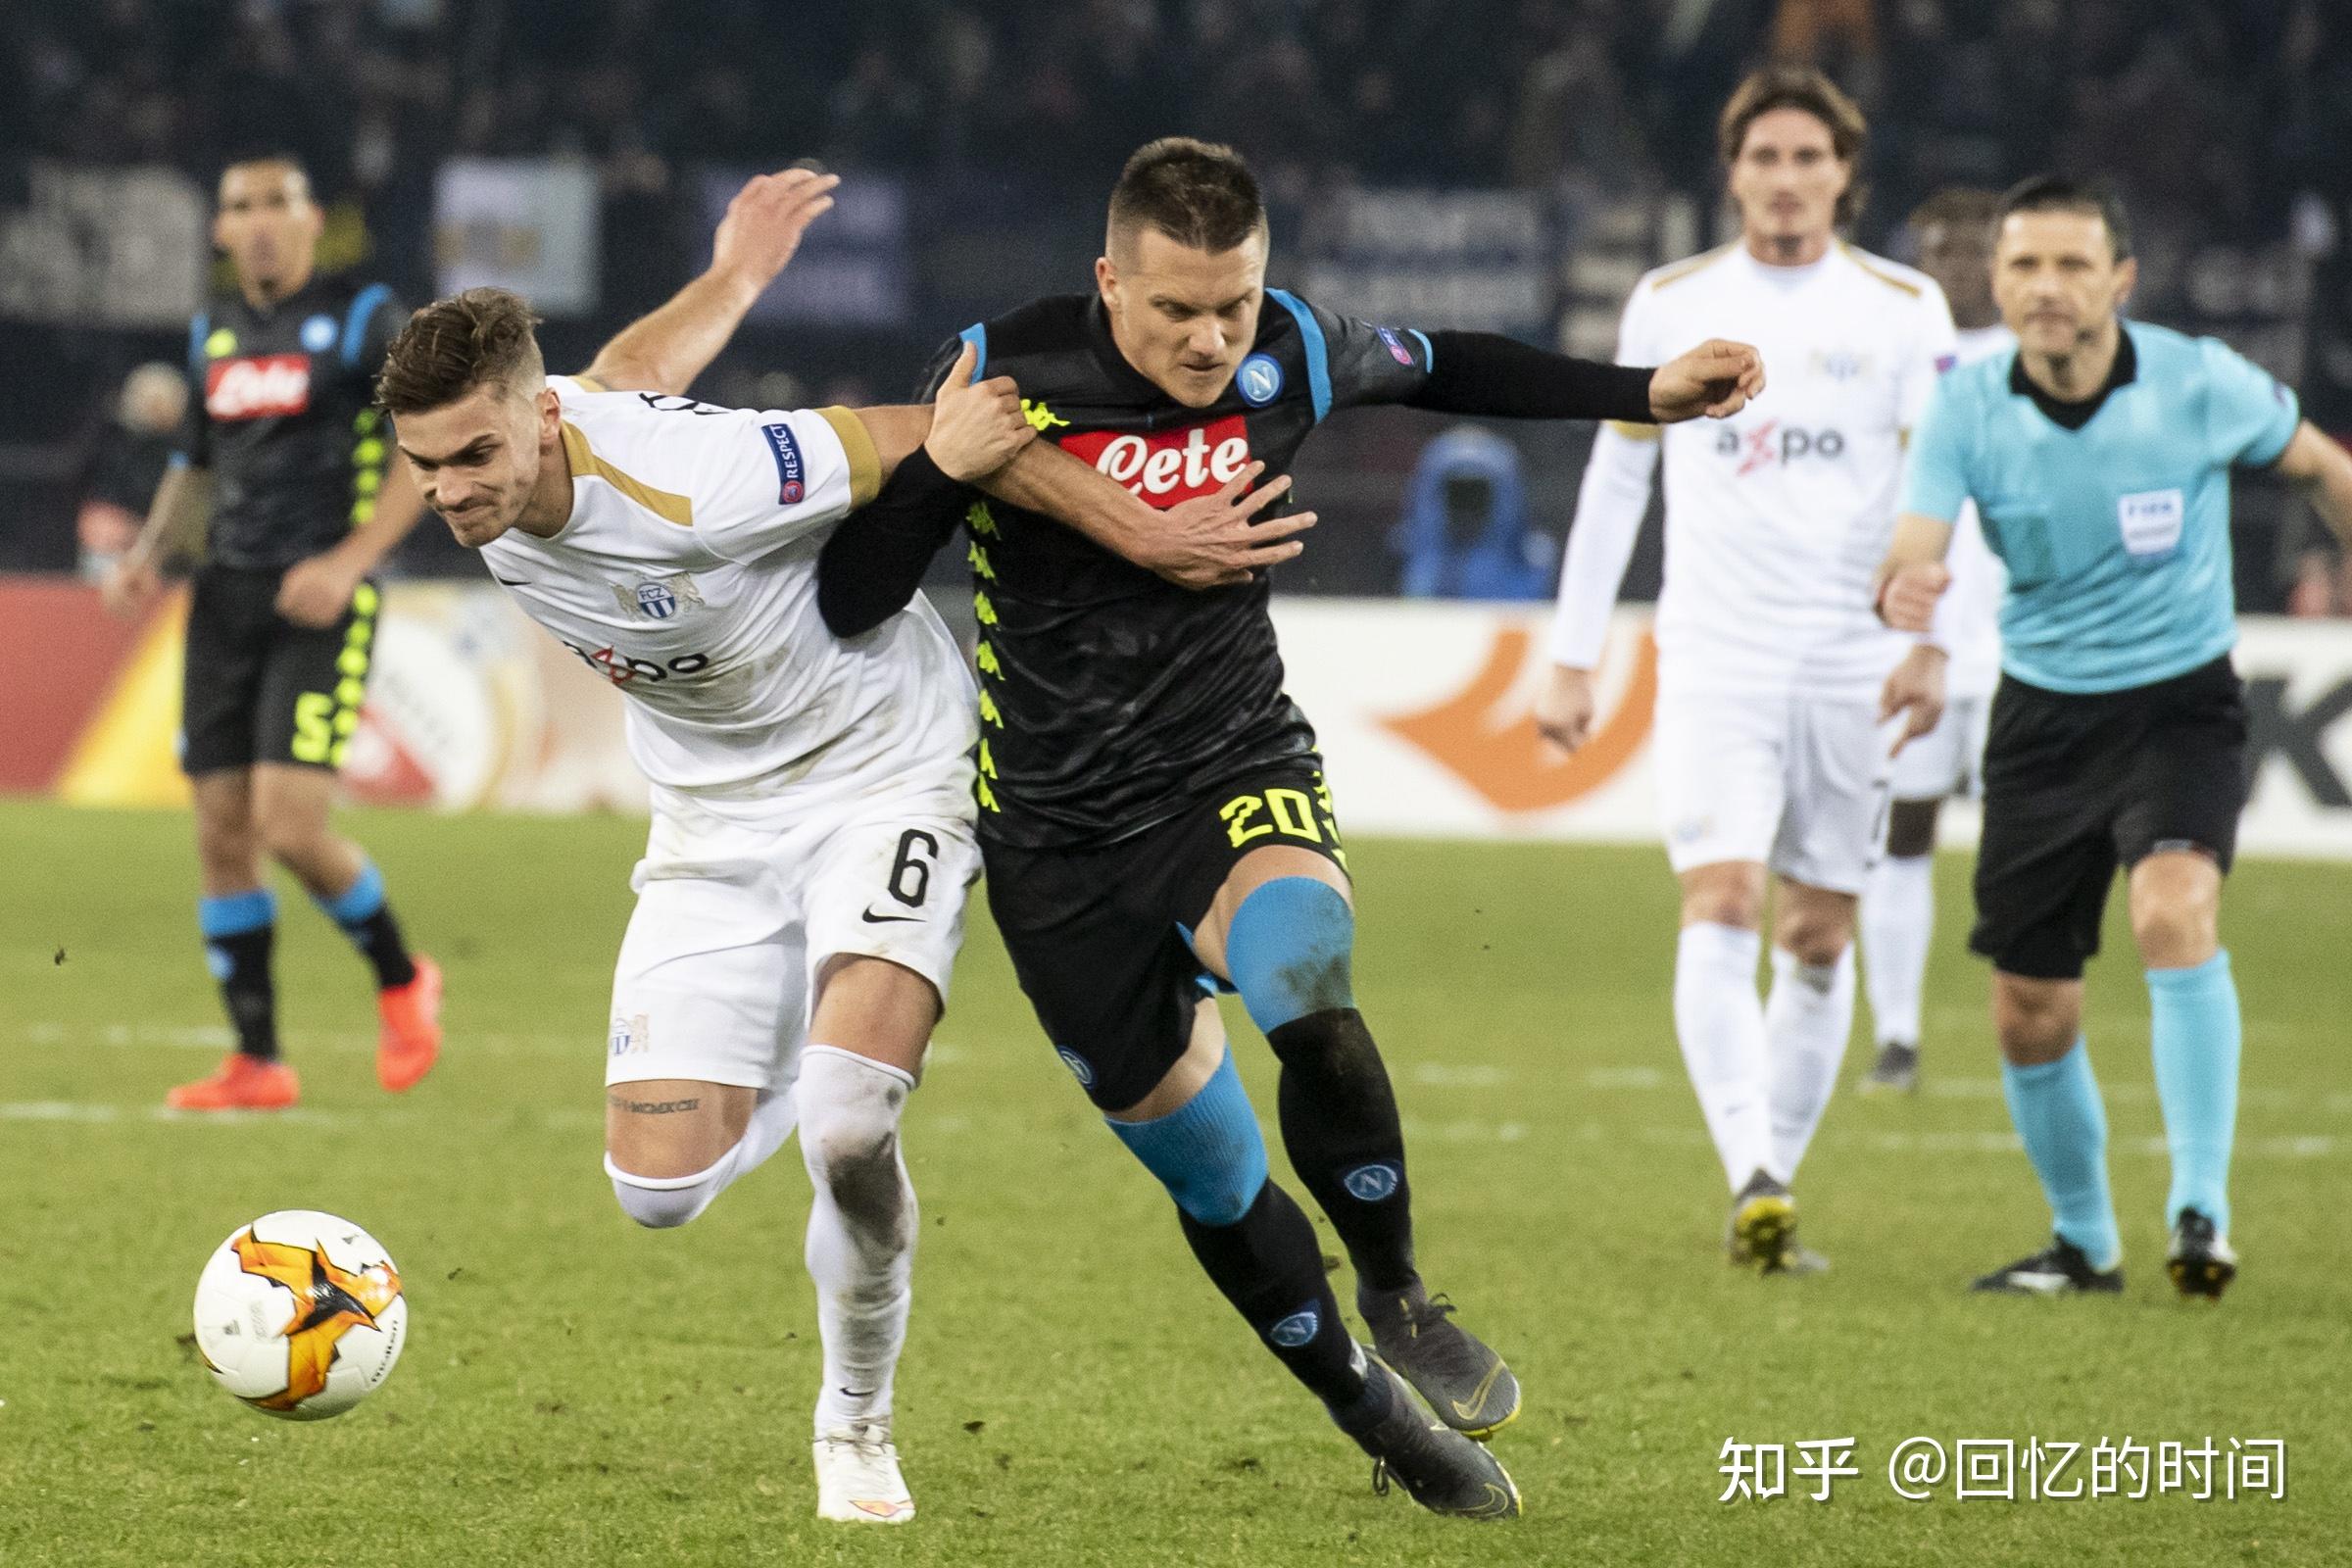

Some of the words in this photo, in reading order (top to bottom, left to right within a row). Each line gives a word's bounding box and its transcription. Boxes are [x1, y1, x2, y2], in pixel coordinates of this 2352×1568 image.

[769, 424, 800, 479] RESPECT
[639, 587, 666, 601] FCZ
[292, 691, 333, 764] 5
[1219, 788, 1322, 849] 20
[888, 828, 939, 908] 6
